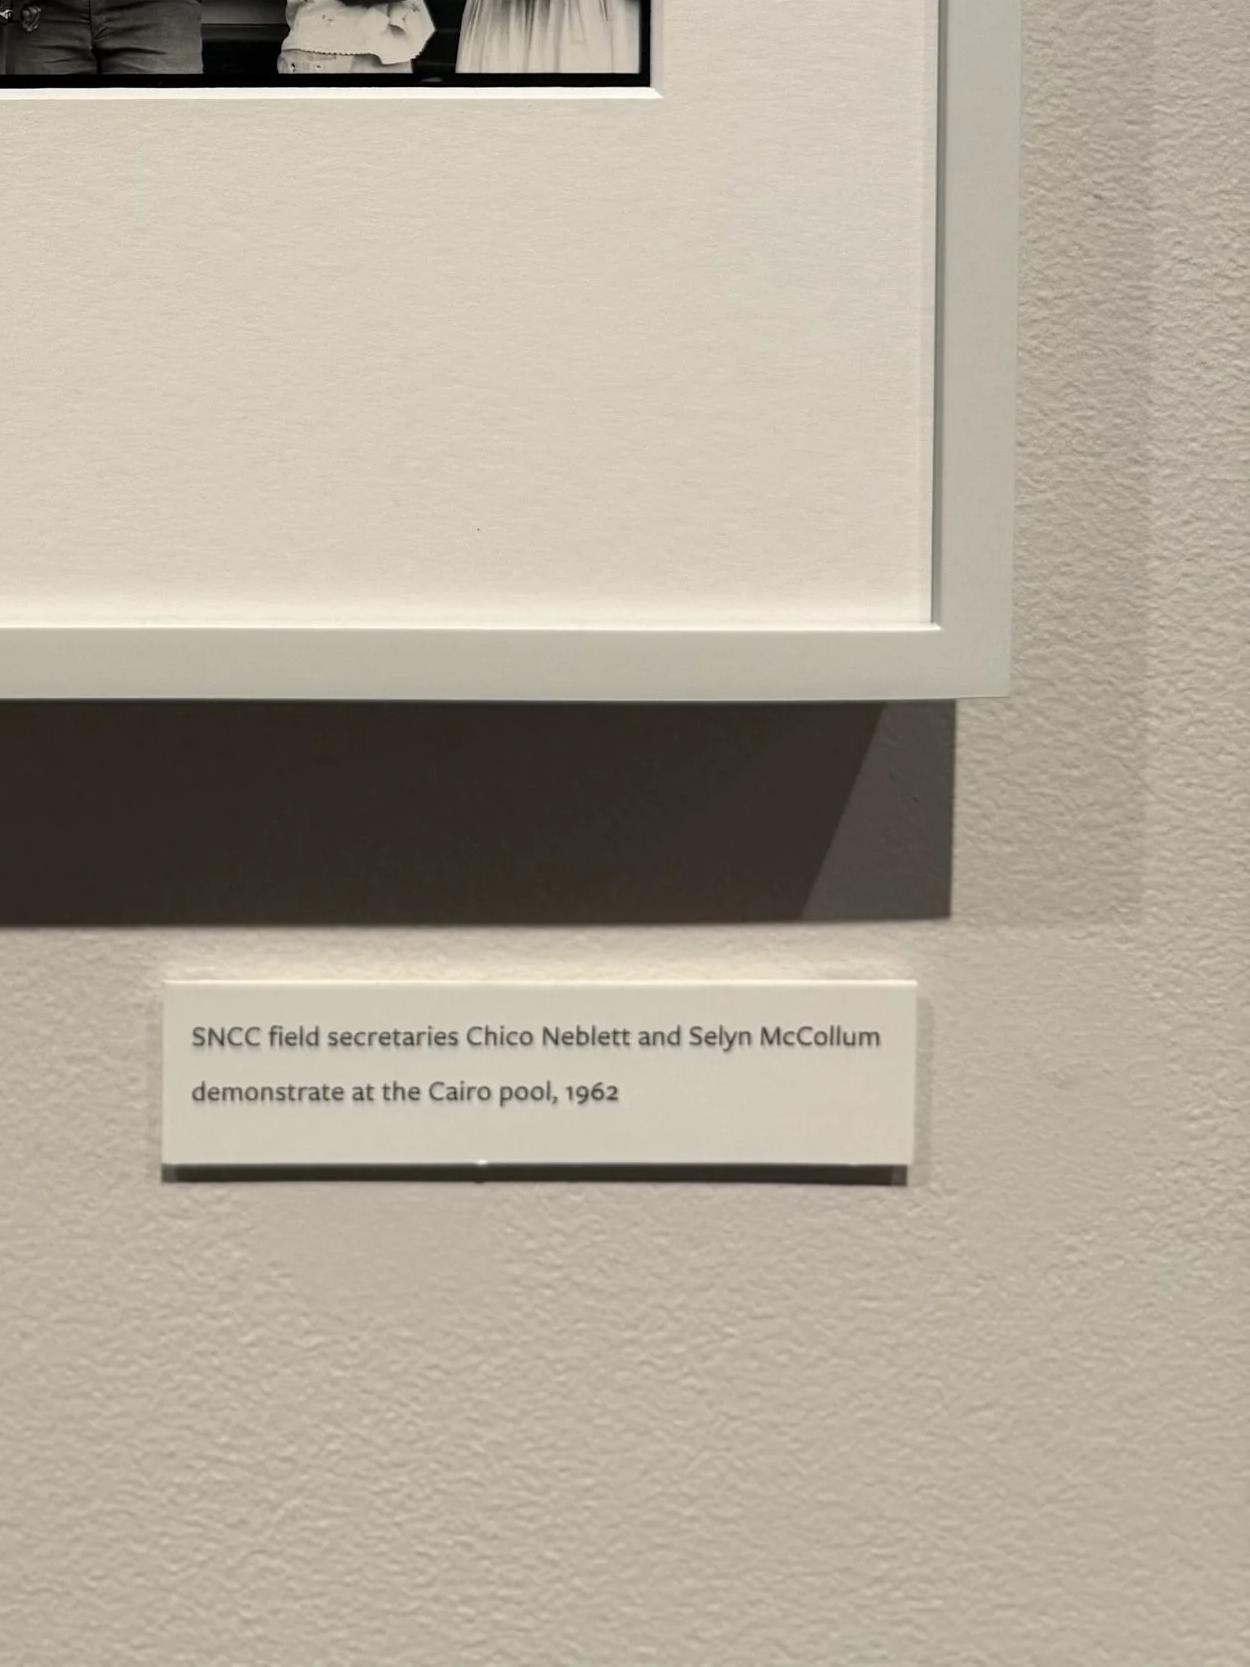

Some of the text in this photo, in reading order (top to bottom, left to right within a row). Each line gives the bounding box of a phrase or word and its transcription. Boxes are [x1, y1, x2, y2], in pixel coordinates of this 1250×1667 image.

[192, 1024, 881, 1054] SNCC field secretaries Chico Neblett and Selyn McCollum
[191, 1080, 619, 1109] demonstrate at the Cairo pool, 1962
